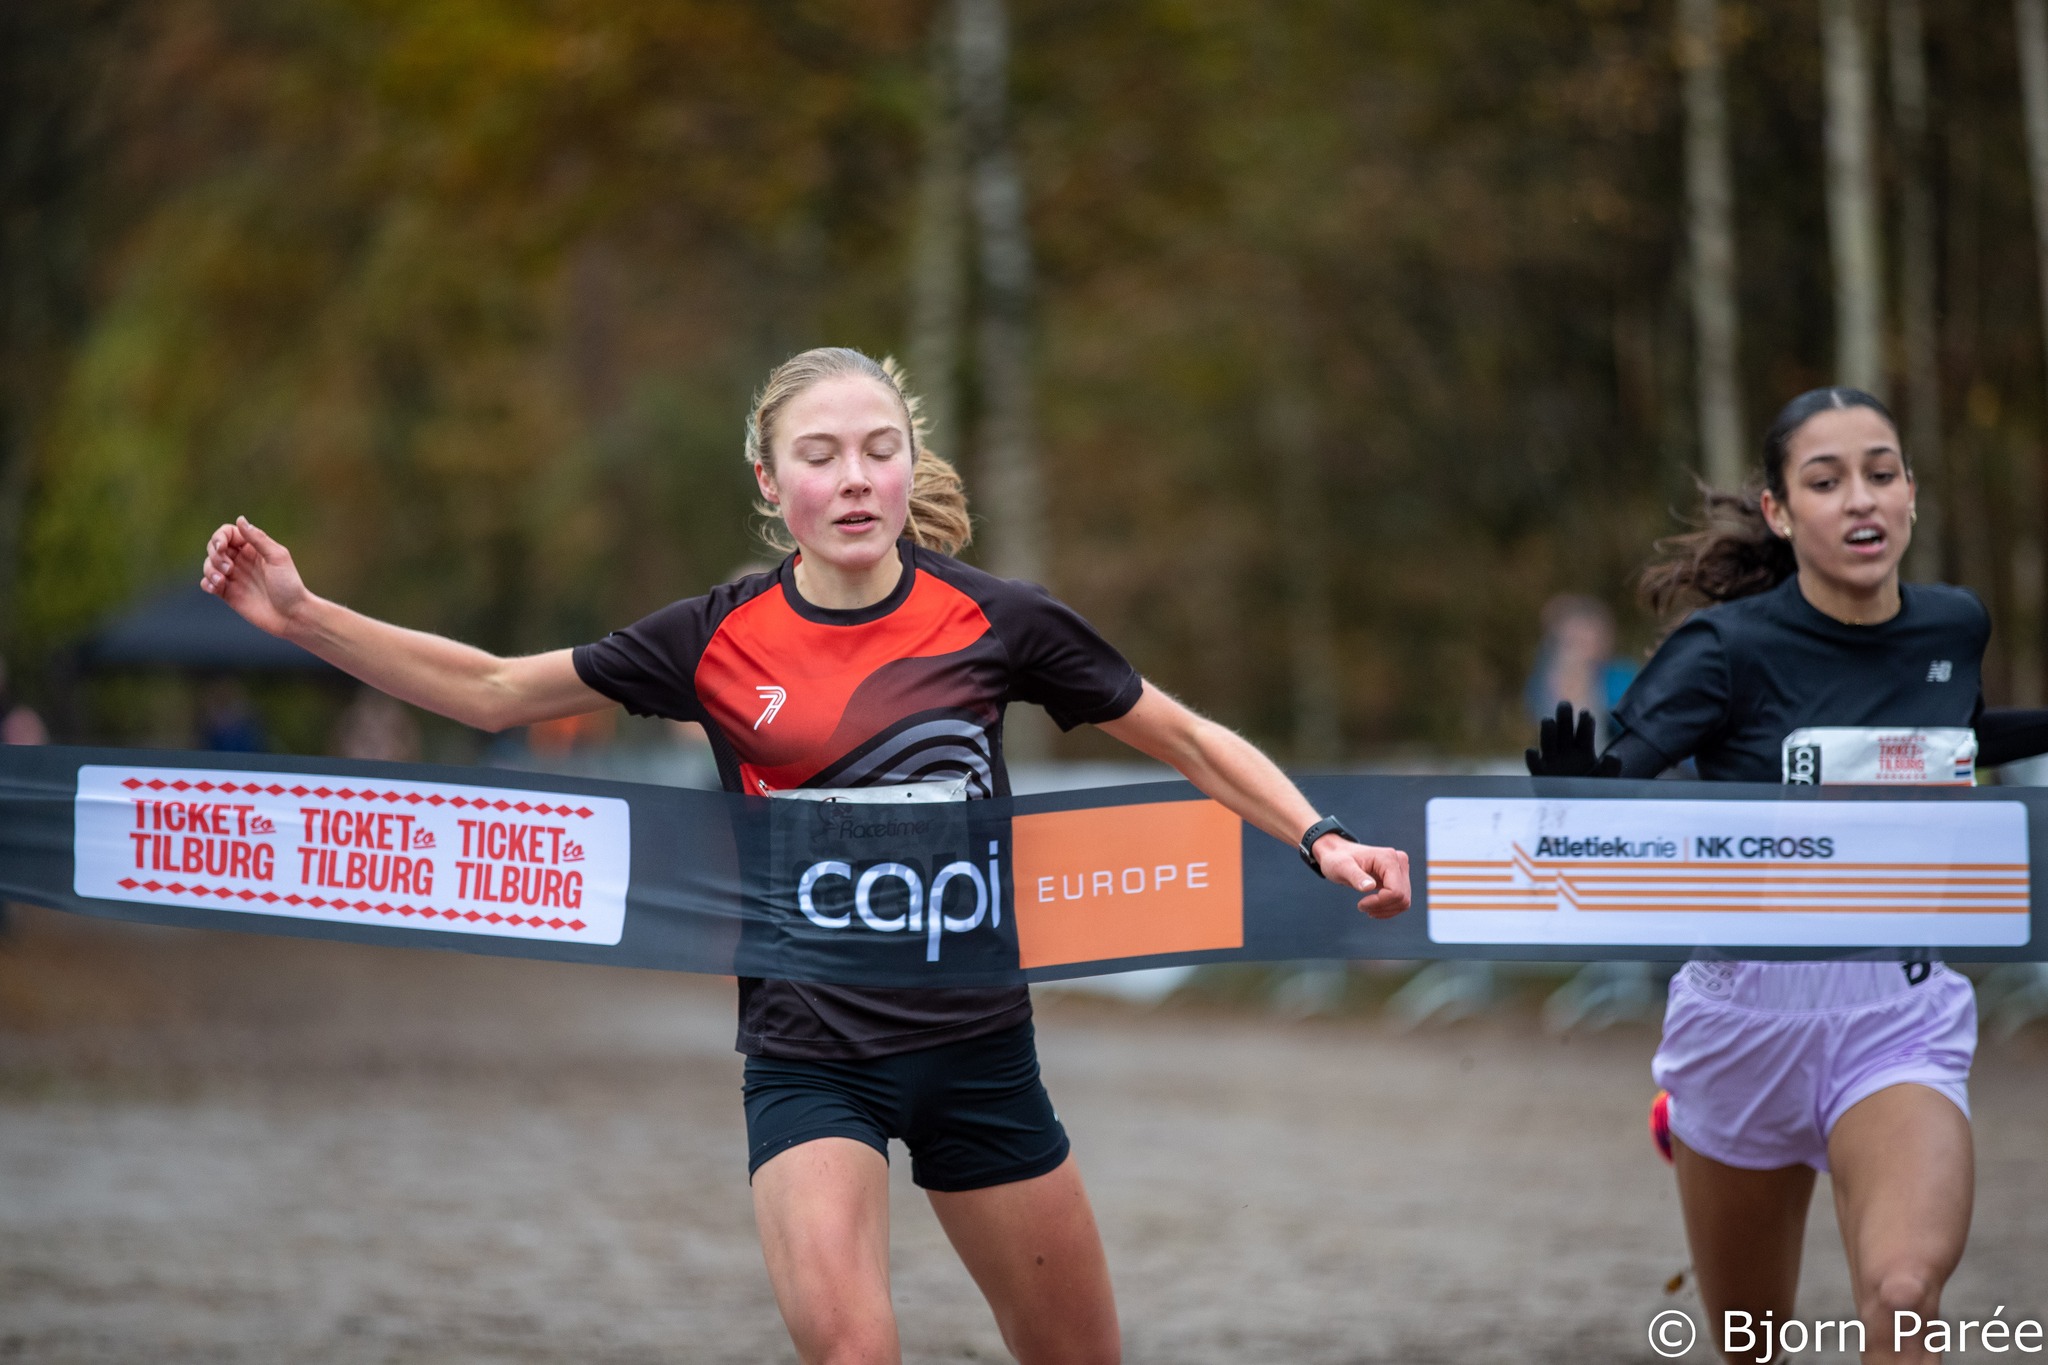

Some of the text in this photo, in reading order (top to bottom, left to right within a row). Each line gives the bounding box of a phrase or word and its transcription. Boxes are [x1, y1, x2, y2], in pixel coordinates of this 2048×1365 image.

[131, 799, 277, 837] TICKET to
[300, 807, 437, 852] TICKET to
[129, 832, 275, 881] TILBURG
[457, 819, 585, 865] TICKET to
[1535, 836, 1835, 859] Atletiekunie NK CROSS
[297, 846, 434, 897] TILBURG
[455, 861, 583, 910] TILBURG
[1037, 861, 1210, 903] EUROPE
[797, 839, 1001, 962] capi
